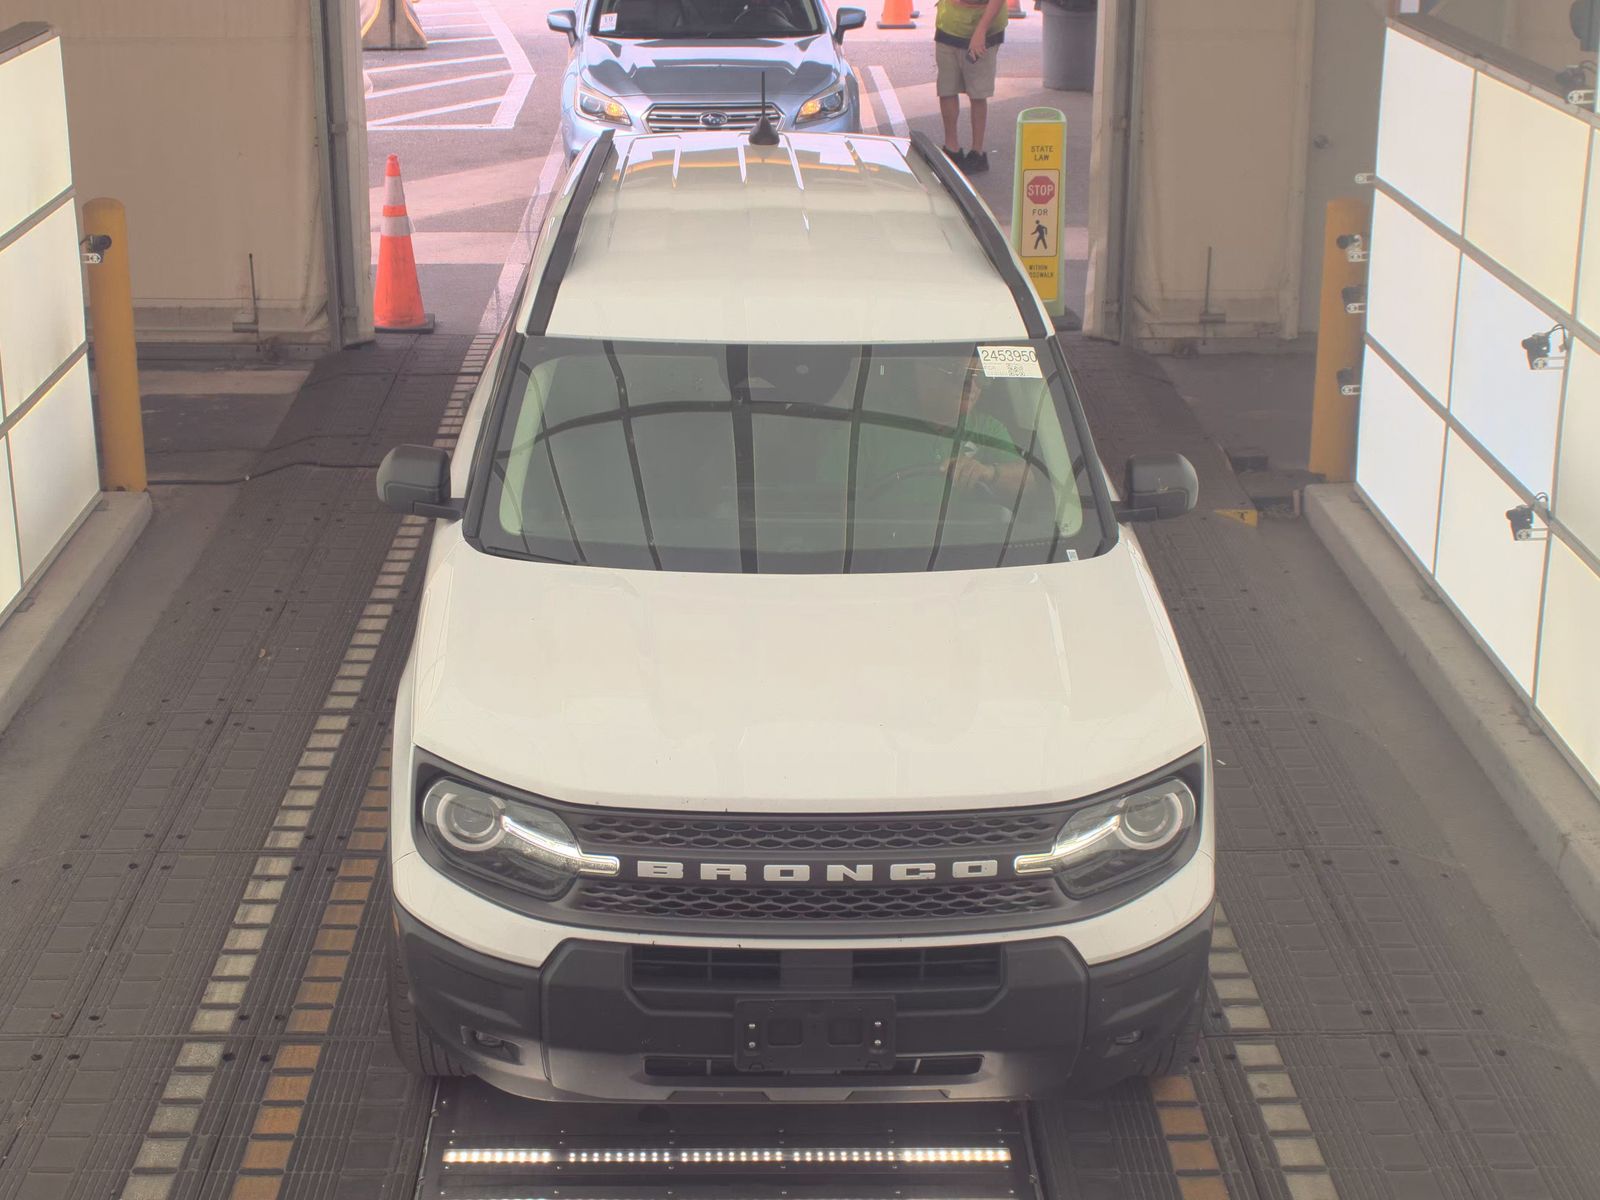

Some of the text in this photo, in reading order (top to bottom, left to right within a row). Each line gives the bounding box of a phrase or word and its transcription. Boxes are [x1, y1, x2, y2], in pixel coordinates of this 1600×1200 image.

[1031, 145, 1054, 153] STATE
[1028, 184, 1054, 197] STOP
[1032, 208, 1049, 216] FOR
[981, 350, 1038, 363] 2453950
[637, 859, 998, 882] BRONCO
